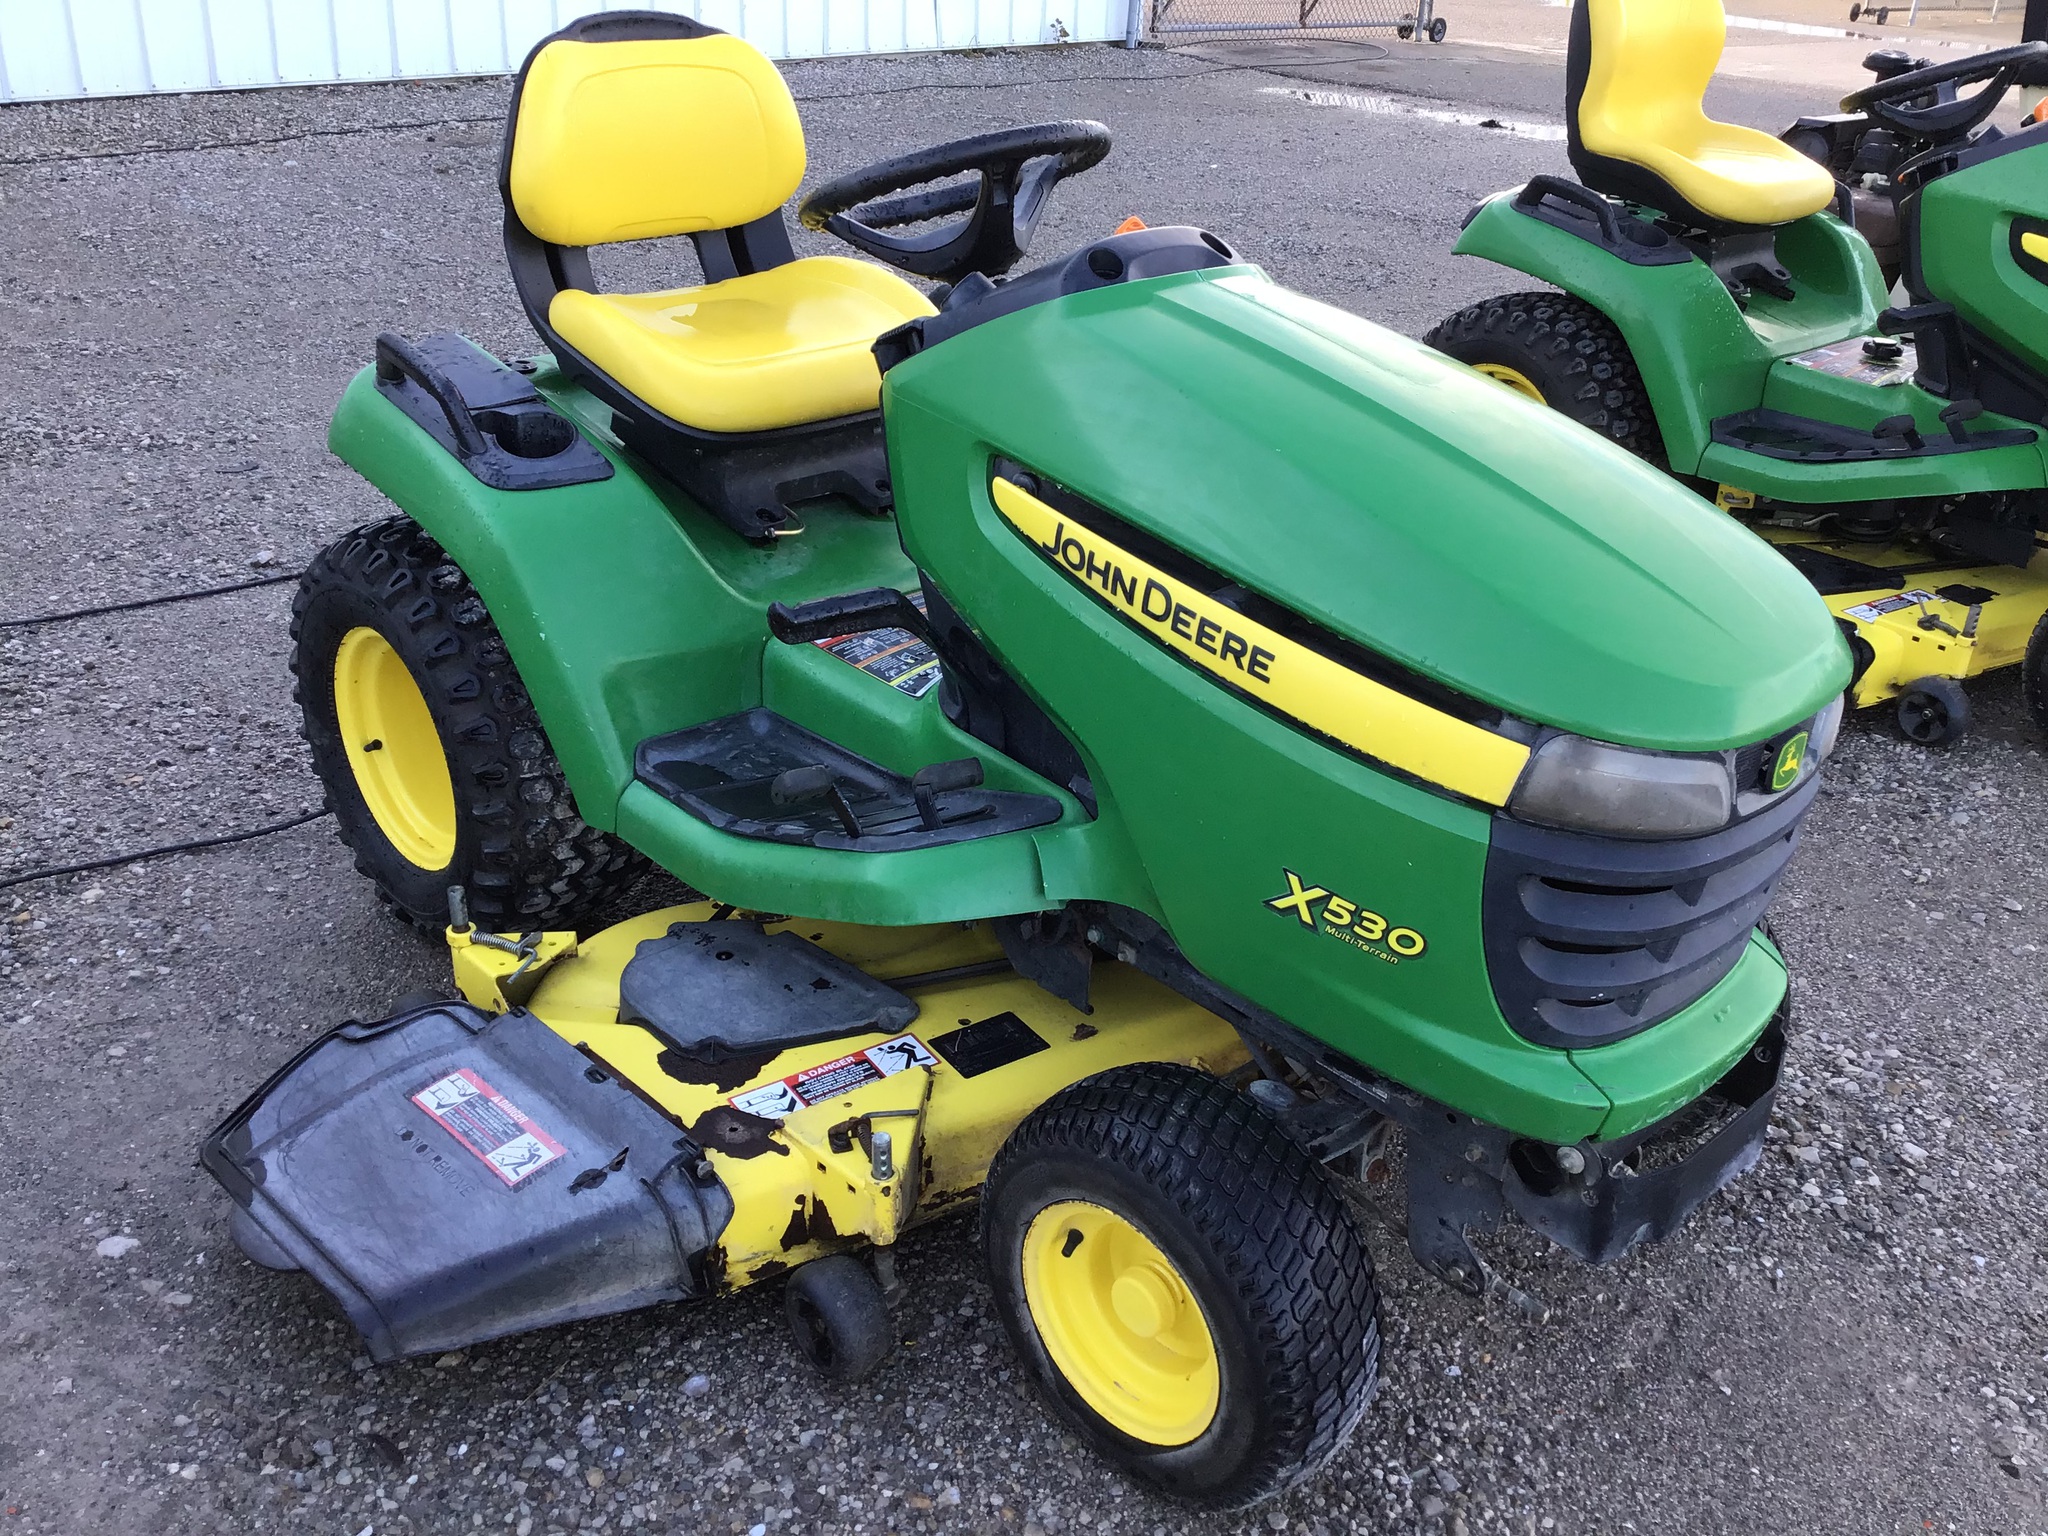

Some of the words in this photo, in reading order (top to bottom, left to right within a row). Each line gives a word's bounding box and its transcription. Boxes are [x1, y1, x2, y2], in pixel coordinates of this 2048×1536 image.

[1042, 522, 1138, 607] JOHN
[1141, 578, 1276, 684] DEERE
[1263, 867, 1427, 958] X530
[1324, 924, 1399, 966] Multi-Terrain
[807, 1056, 856, 1077] DANGER
[500, 1097, 529, 1123] DANGER
[411, 1138, 436, 1158] NOT
[429, 1155, 475, 1198] REMOVE
